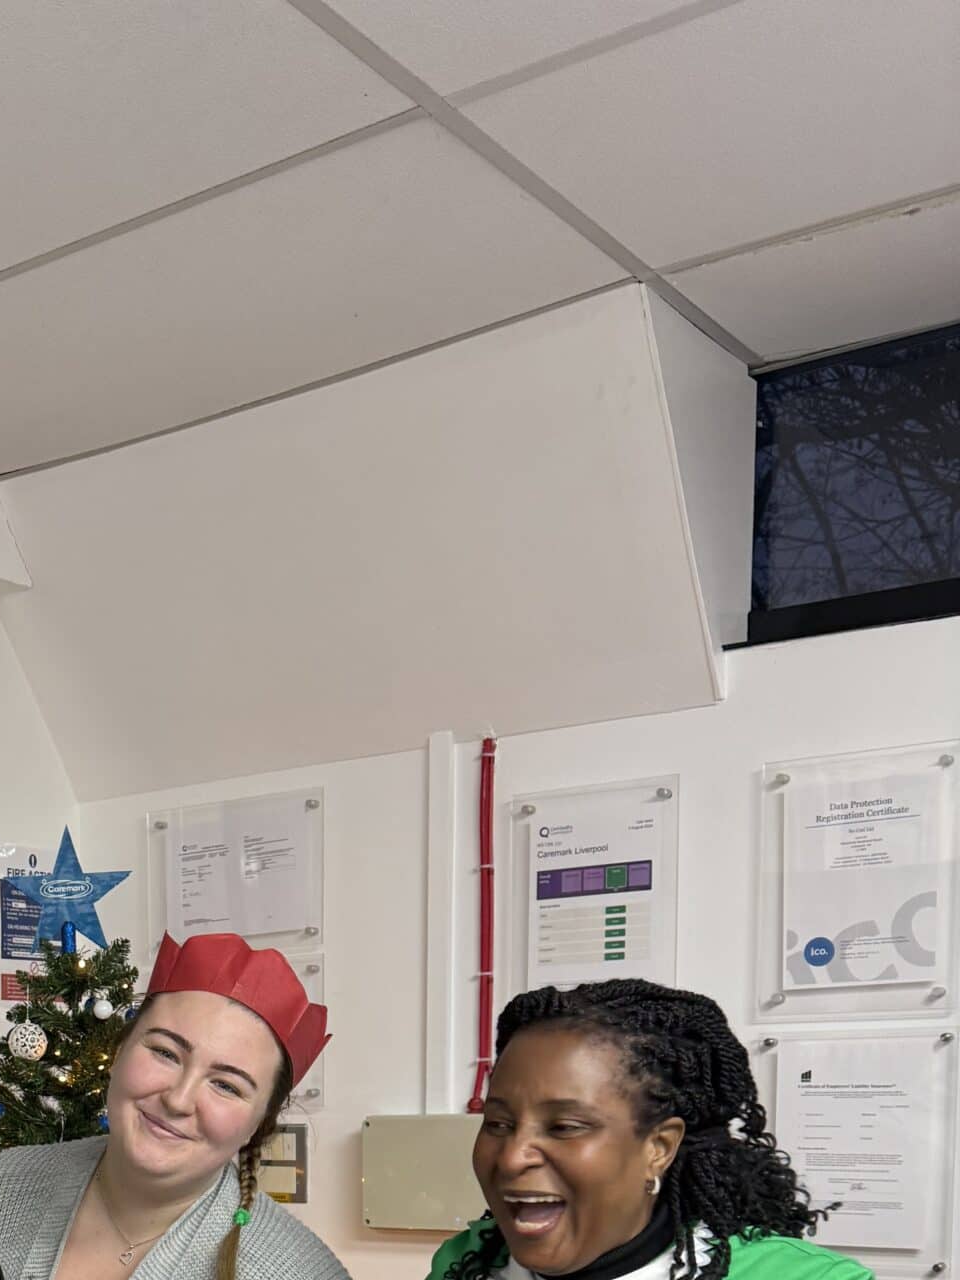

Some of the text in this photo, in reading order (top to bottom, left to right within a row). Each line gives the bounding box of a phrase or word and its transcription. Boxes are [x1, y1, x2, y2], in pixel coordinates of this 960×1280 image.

[829, 797, 893, 811] Data Protection
[815, 806, 910, 823] Registration Certificate
[537, 848, 572, 858] Caremark
[574, 843, 609, 855] Liverpool
